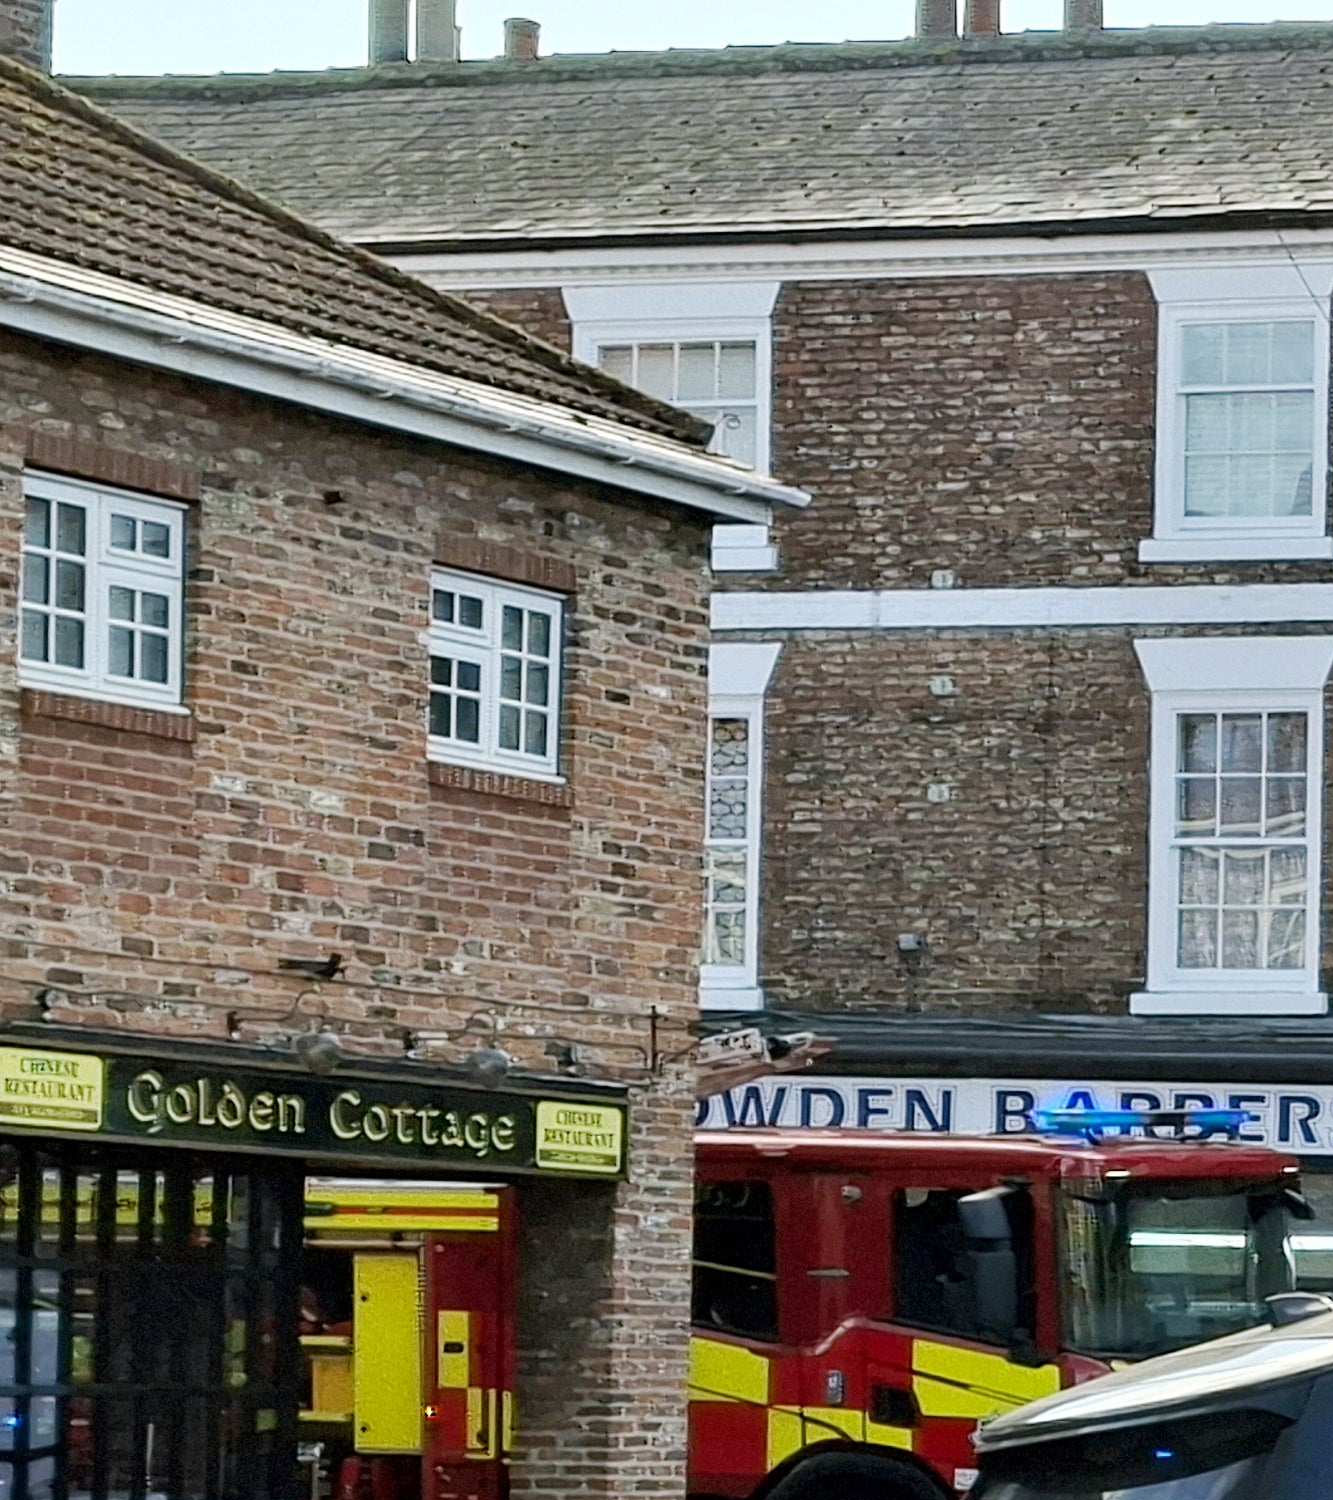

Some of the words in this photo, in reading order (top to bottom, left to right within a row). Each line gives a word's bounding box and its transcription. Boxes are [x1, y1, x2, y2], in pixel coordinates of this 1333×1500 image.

[5, 1077, 97, 1103] RESTAURANT
[127, 1069, 306, 1134] Golden
[329, 1089, 517, 1158] Cottage
